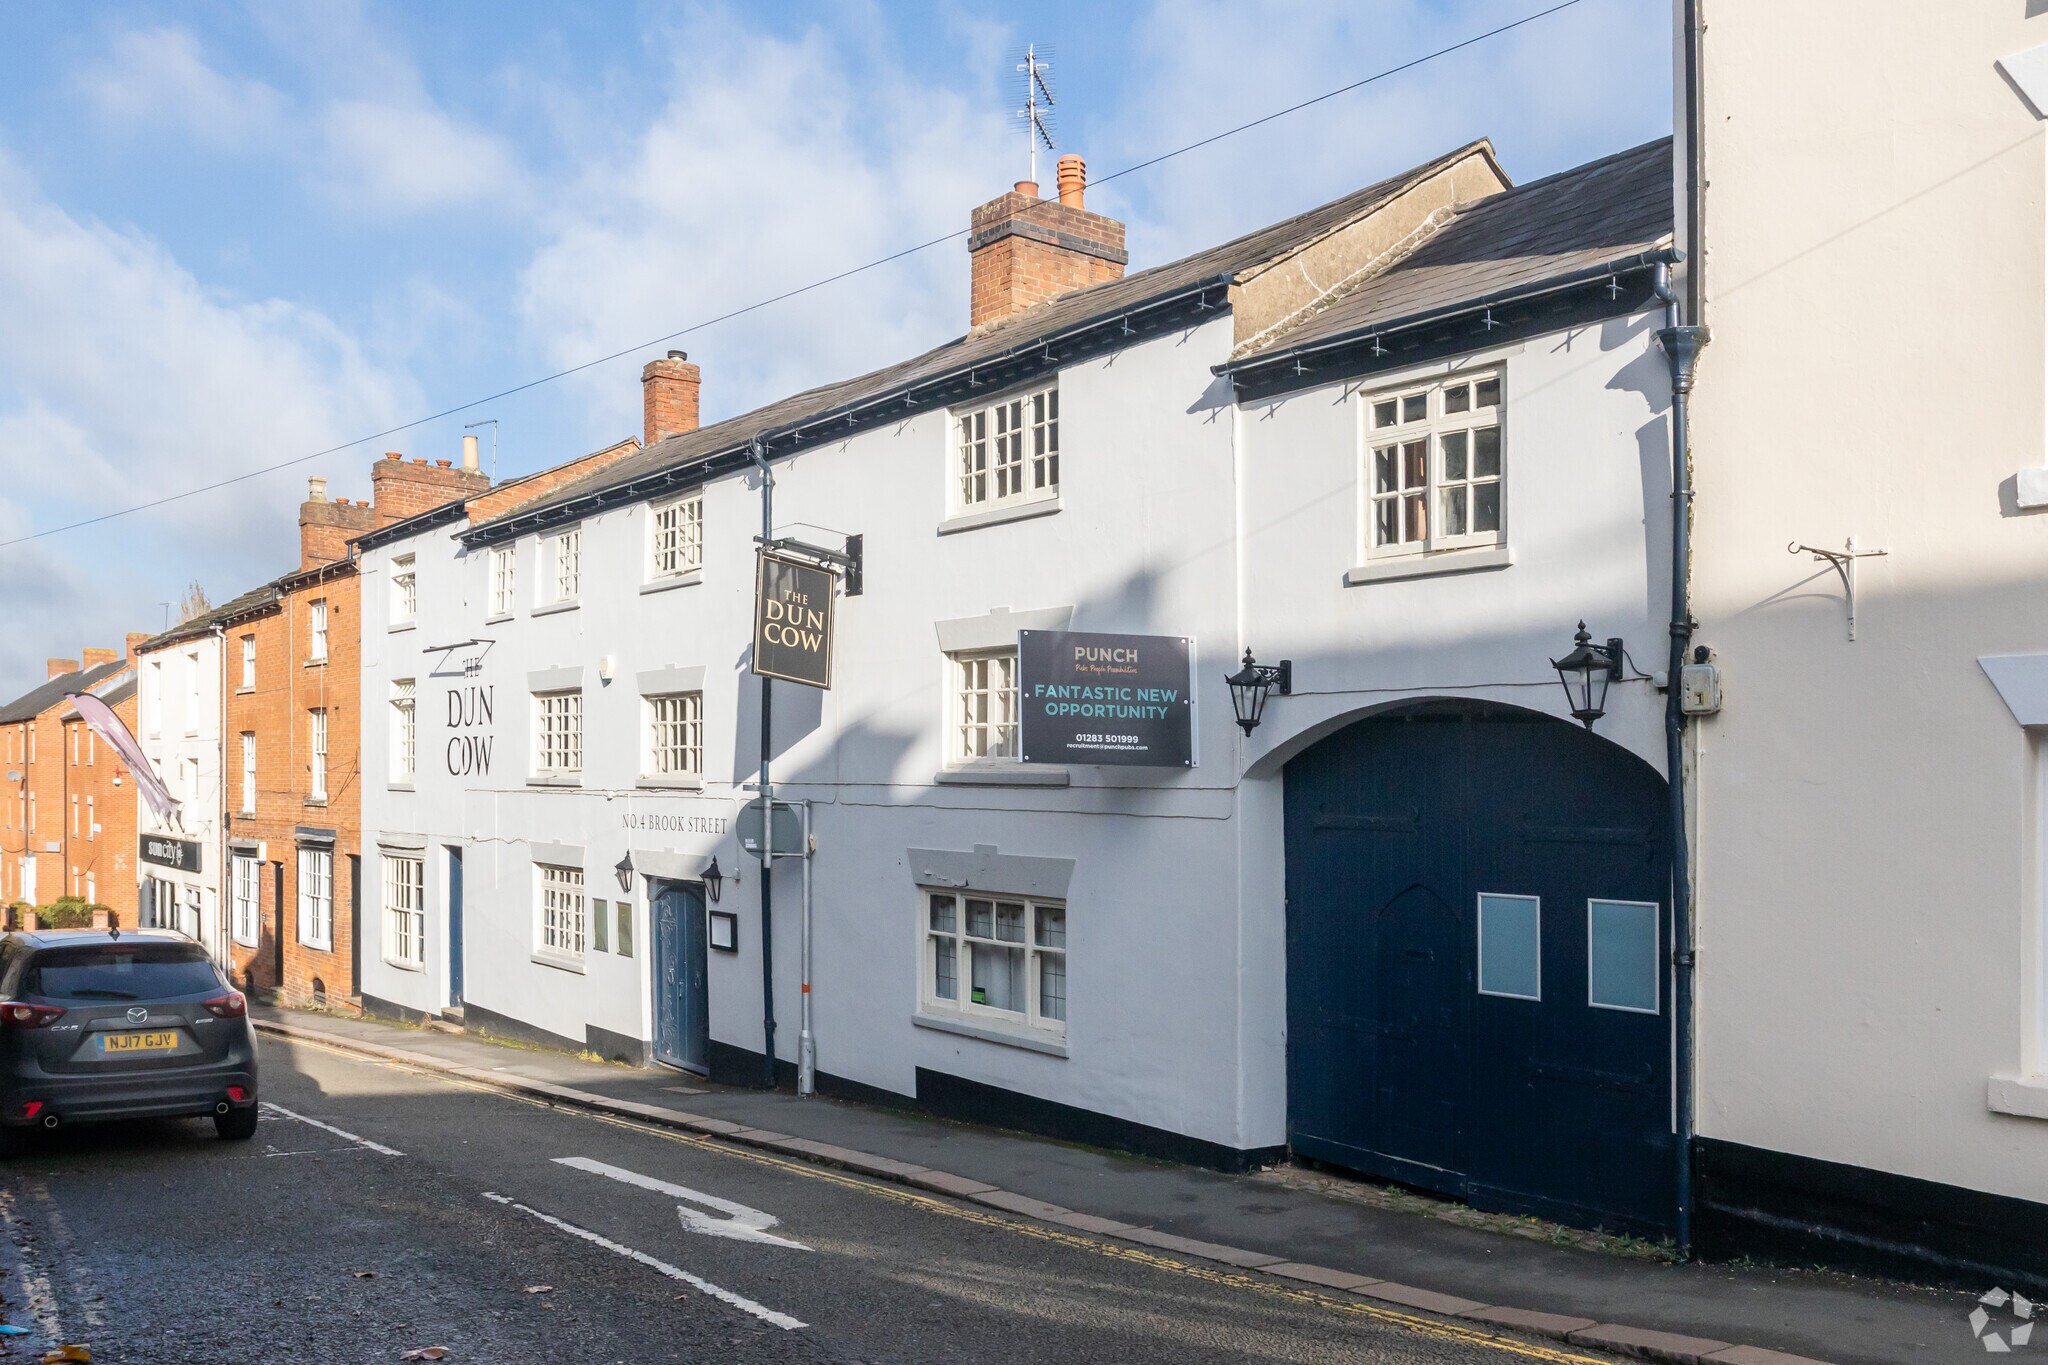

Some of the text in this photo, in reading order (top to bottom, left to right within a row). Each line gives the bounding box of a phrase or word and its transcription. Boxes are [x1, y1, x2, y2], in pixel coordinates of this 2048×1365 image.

[784, 589, 809, 605] THE
[766, 598, 825, 632] DUN
[764, 622, 824, 653] COW
[1074, 646, 1138, 663] PUNCH
[1034, 684, 1178, 703] FANTASTIC NEW
[447, 685, 494, 728] DUN
[1045, 702, 1168, 720] OPPORTUNITY
[1066, 743, 1149, 751] recruitment@punchpubs.com
[1076, 733, 1139, 744] 01283 501999
[447, 735, 494, 776] COW
[649, 814, 685, 831] BROOK
[688, 816, 728, 834] STREET
[51, 1024, 79, 1032] CX-5
[109, 1033, 173, 1049] NJ17 GJV
